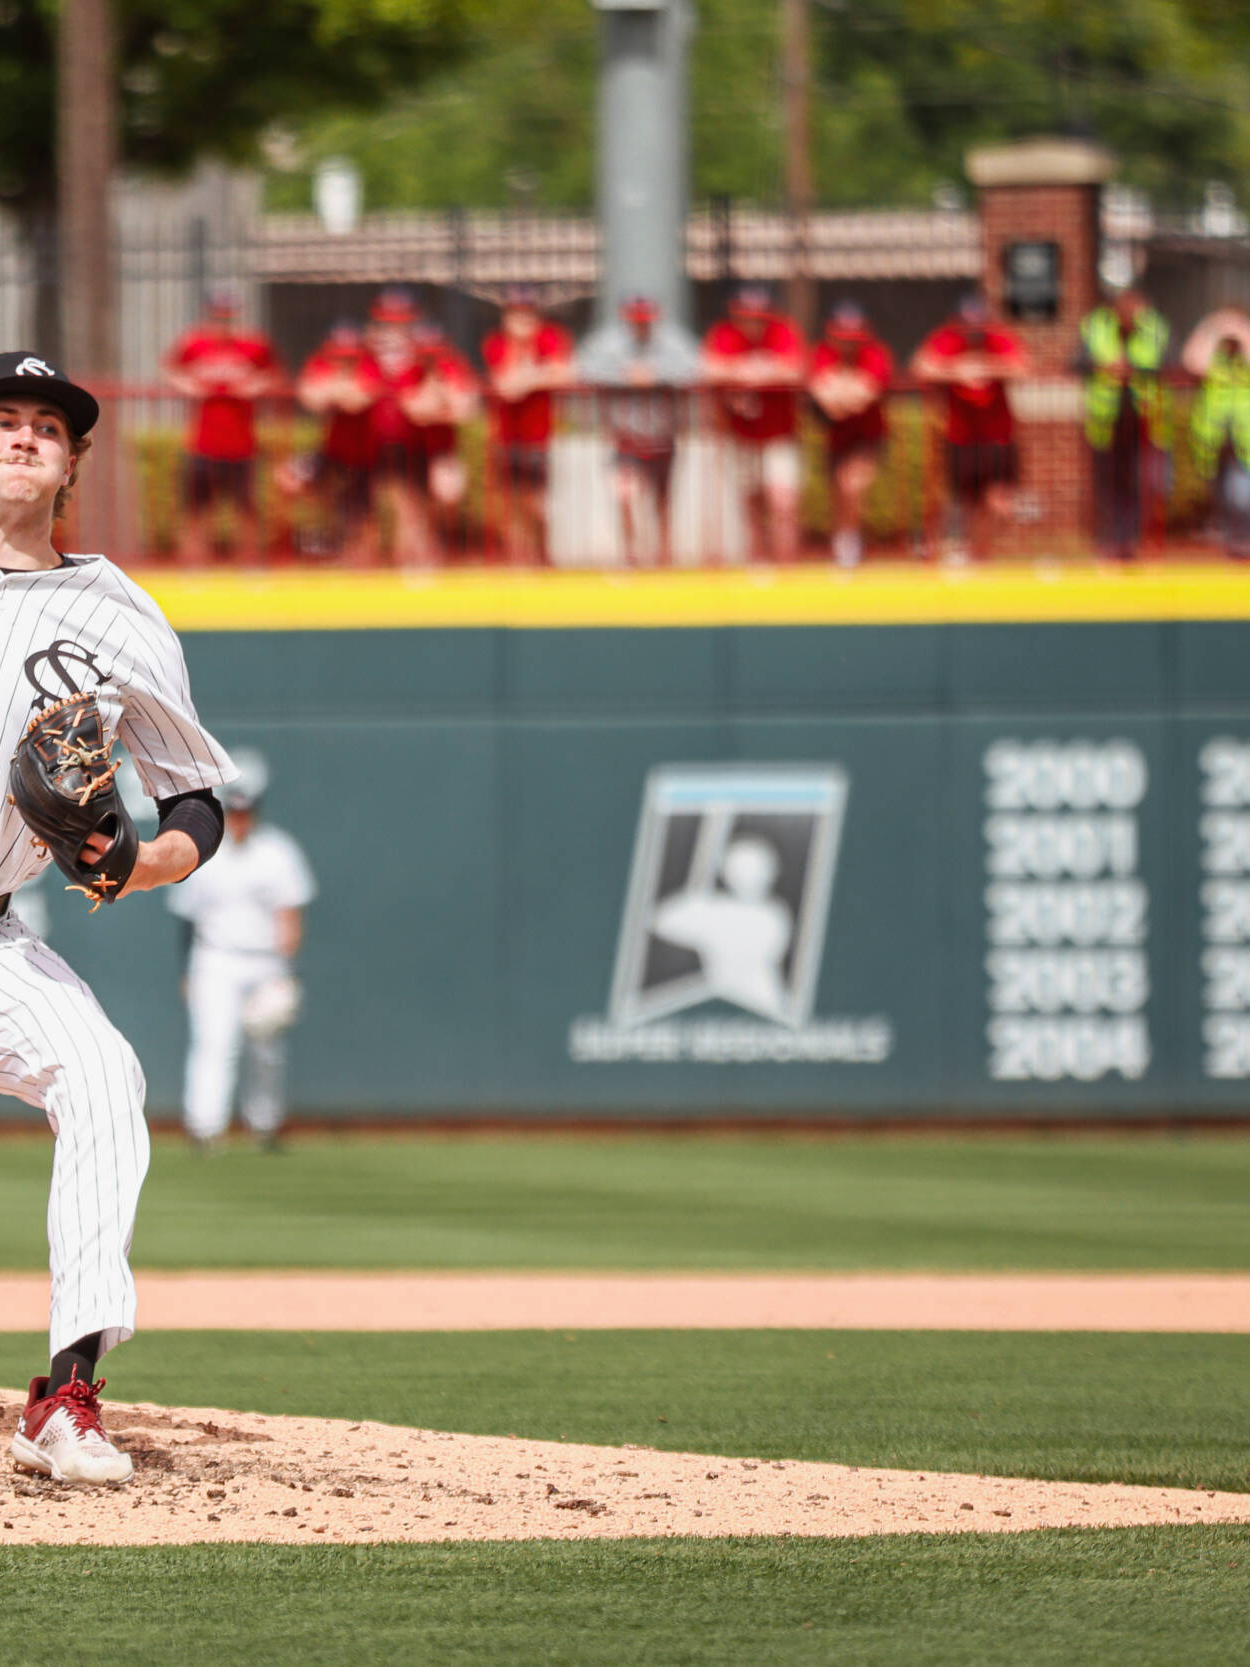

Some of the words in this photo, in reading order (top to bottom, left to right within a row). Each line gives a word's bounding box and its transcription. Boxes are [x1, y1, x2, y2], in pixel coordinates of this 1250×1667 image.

[984, 740, 1148, 809] 2000
[984, 812, 1140, 877] 2001
[984, 880, 1149, 945] 2002
[985, 948, 1150, 1012] 2003
[987, 1014, 1151, 1081] 2004
